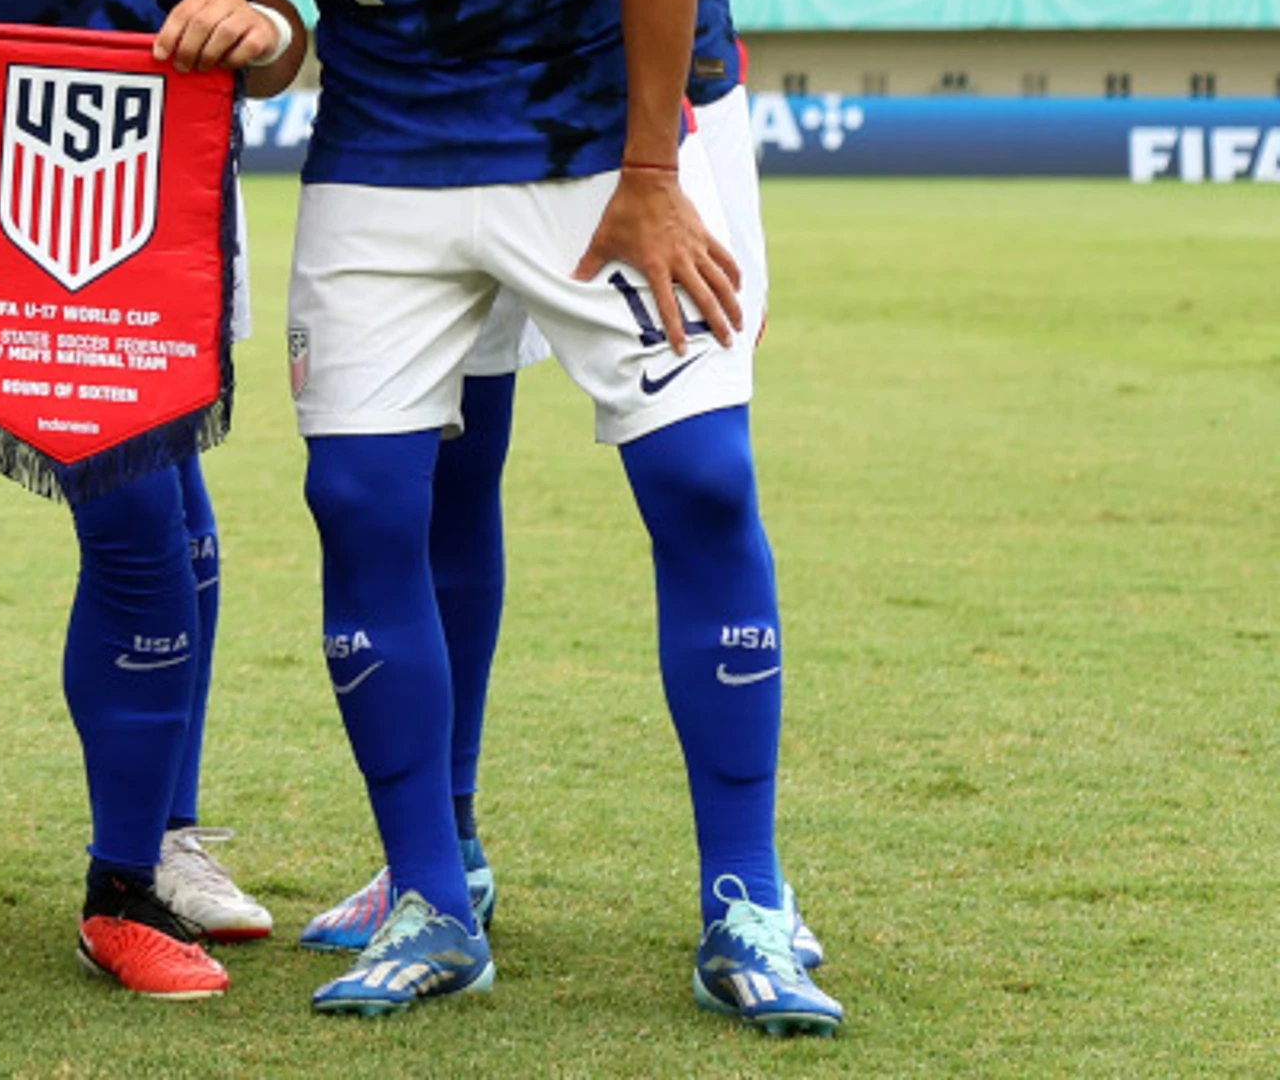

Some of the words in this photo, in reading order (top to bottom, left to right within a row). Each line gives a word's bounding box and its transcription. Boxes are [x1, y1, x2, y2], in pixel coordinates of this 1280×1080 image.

[15, 77, 152, 163] USA
[24, 302, 57, 319] U-17
[63, 305, 122, 325] WORLD
[126, 309, 161, 327] CUP
[0, 328, 50, 348] STATES
[57, 333, 110, 352] SOCCER
[115, 337, 198, 358] FEDERATION
[56, 349, 125, 369] NATIONAL
[128, 353, 168, 371] TEAM
[2, 378, 51, 397] ROUND
[54, 382, 74, 398] OF
[78, 384, 138, 402] SIXTEEN
[37, 416, 100, 435] Indonesia
[190, 535, 216, 559] SA
[133, 631, 190, 654] USA
[721, 625, 777, 651] USA
